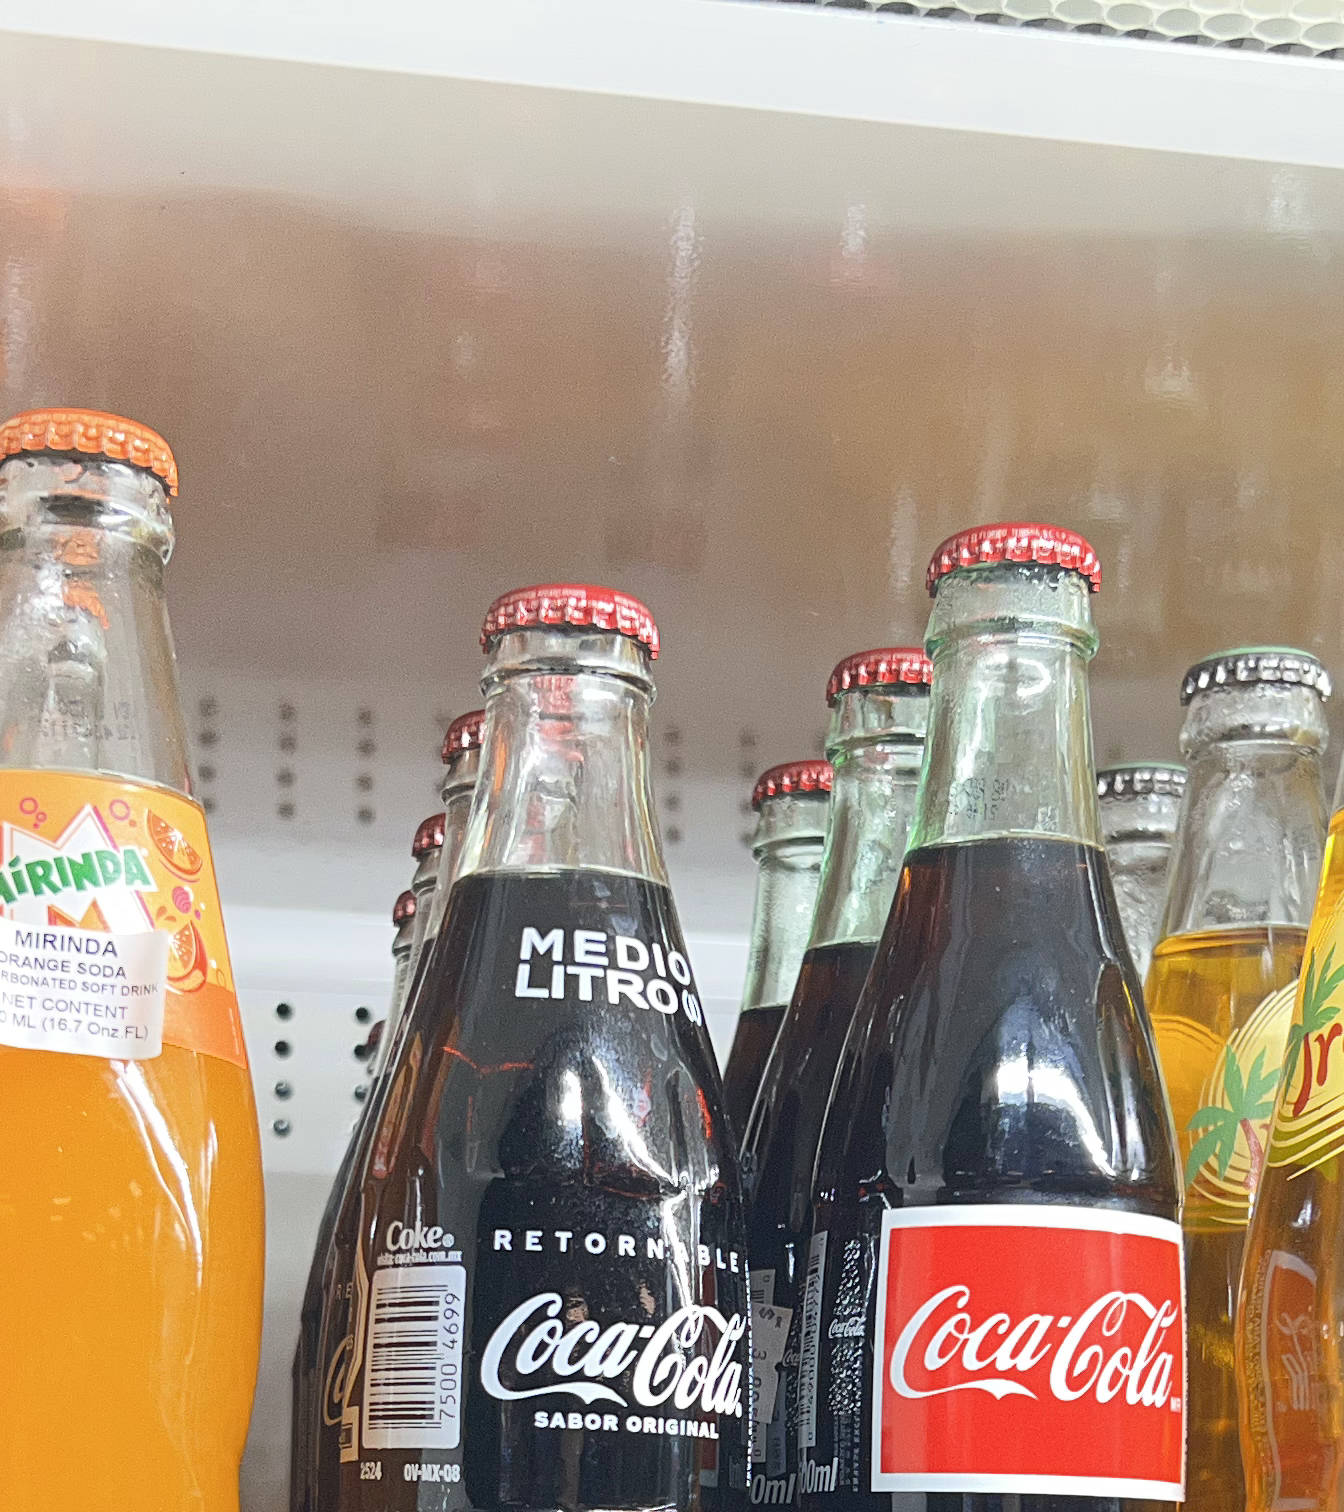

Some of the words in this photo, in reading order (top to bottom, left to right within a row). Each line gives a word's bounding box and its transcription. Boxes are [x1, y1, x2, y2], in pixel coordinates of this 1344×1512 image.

[14, 930, 119, 958] MIRINDA
[519, 926, 692, 987] MEDIO
[77, 961, 127, 980] SODA
[81, 980, 117, 997] SOFT
[514, 963, 680, 1016] LITRO
[1, 992, 38, 1011] NET
[42, 996, 129, 1021] CONTENT
[13, 1011, 37, 1031] ML
[386, 1221, 444, 1252] Coke
[494, 1230, 740, 1274] RETORNABLE
[481, 1293, 743, 1417] Coca-Cola
[890, 1285, 1179, 1409] Coca-Cola
[534, 1410, 620, 1432] SABOR
[626, 1414, 720, 1440] ORIGINAL
